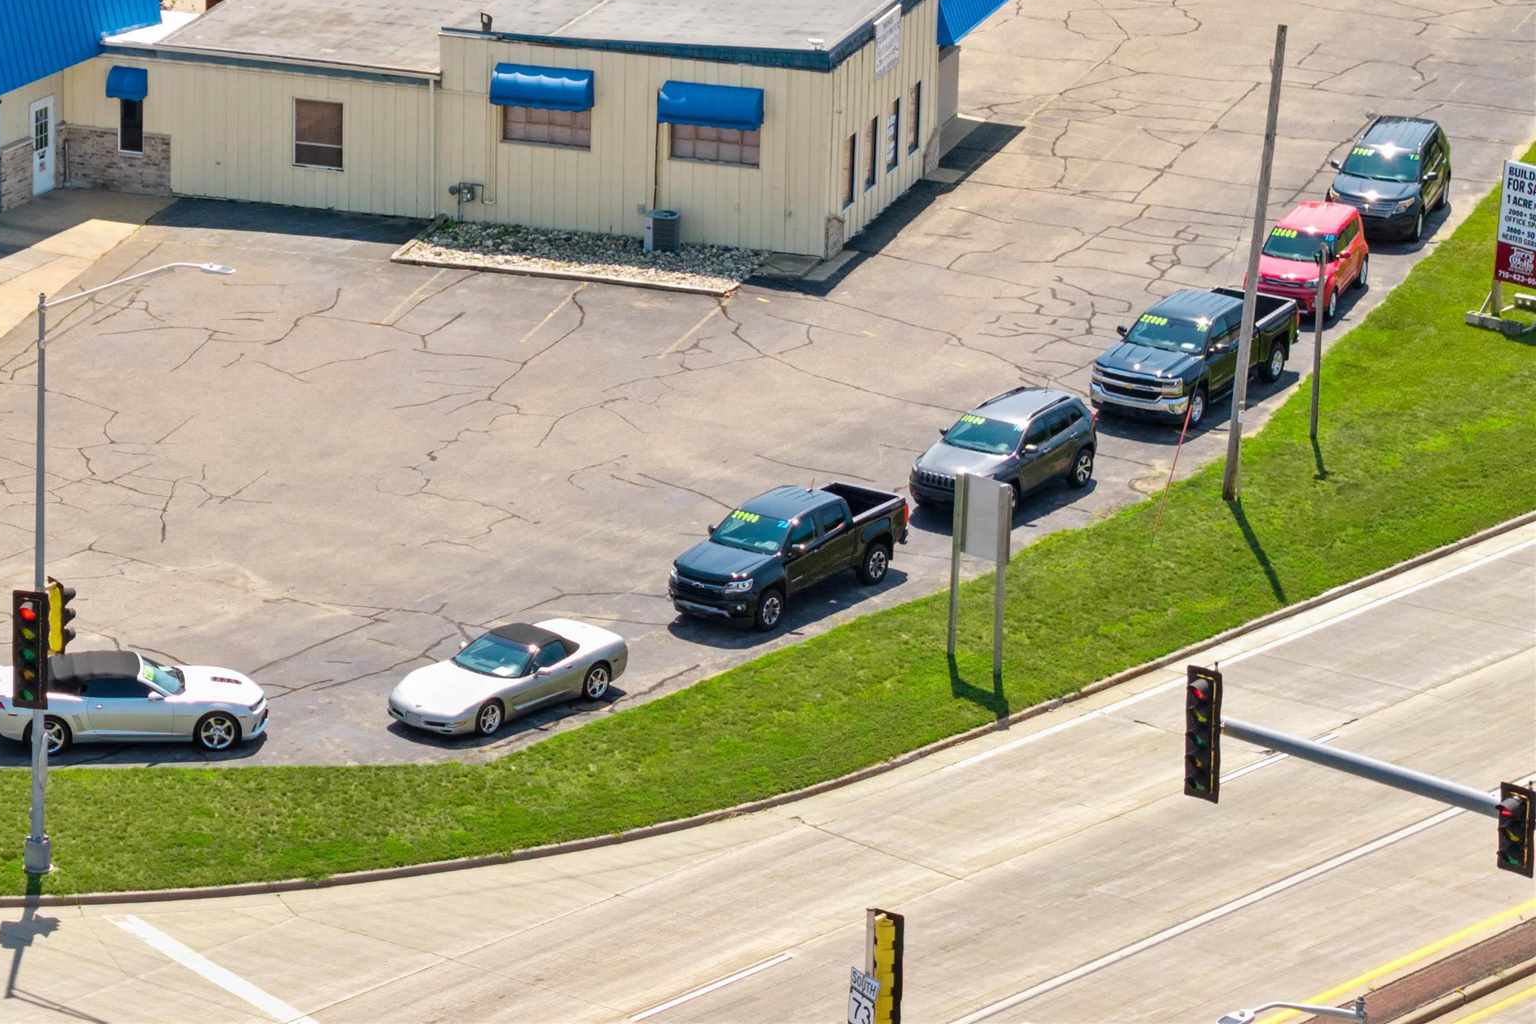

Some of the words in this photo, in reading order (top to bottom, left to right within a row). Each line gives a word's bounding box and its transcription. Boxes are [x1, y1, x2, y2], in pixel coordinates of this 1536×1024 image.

[1509, 166, 1536, 182] BUILD
[1507, 177, 1525, 193] FOR
[1512, 196, 1533, 209] ACRE
[851, 970, 877, 997] SOUTH
[852, 997, 871, 1024] 73
